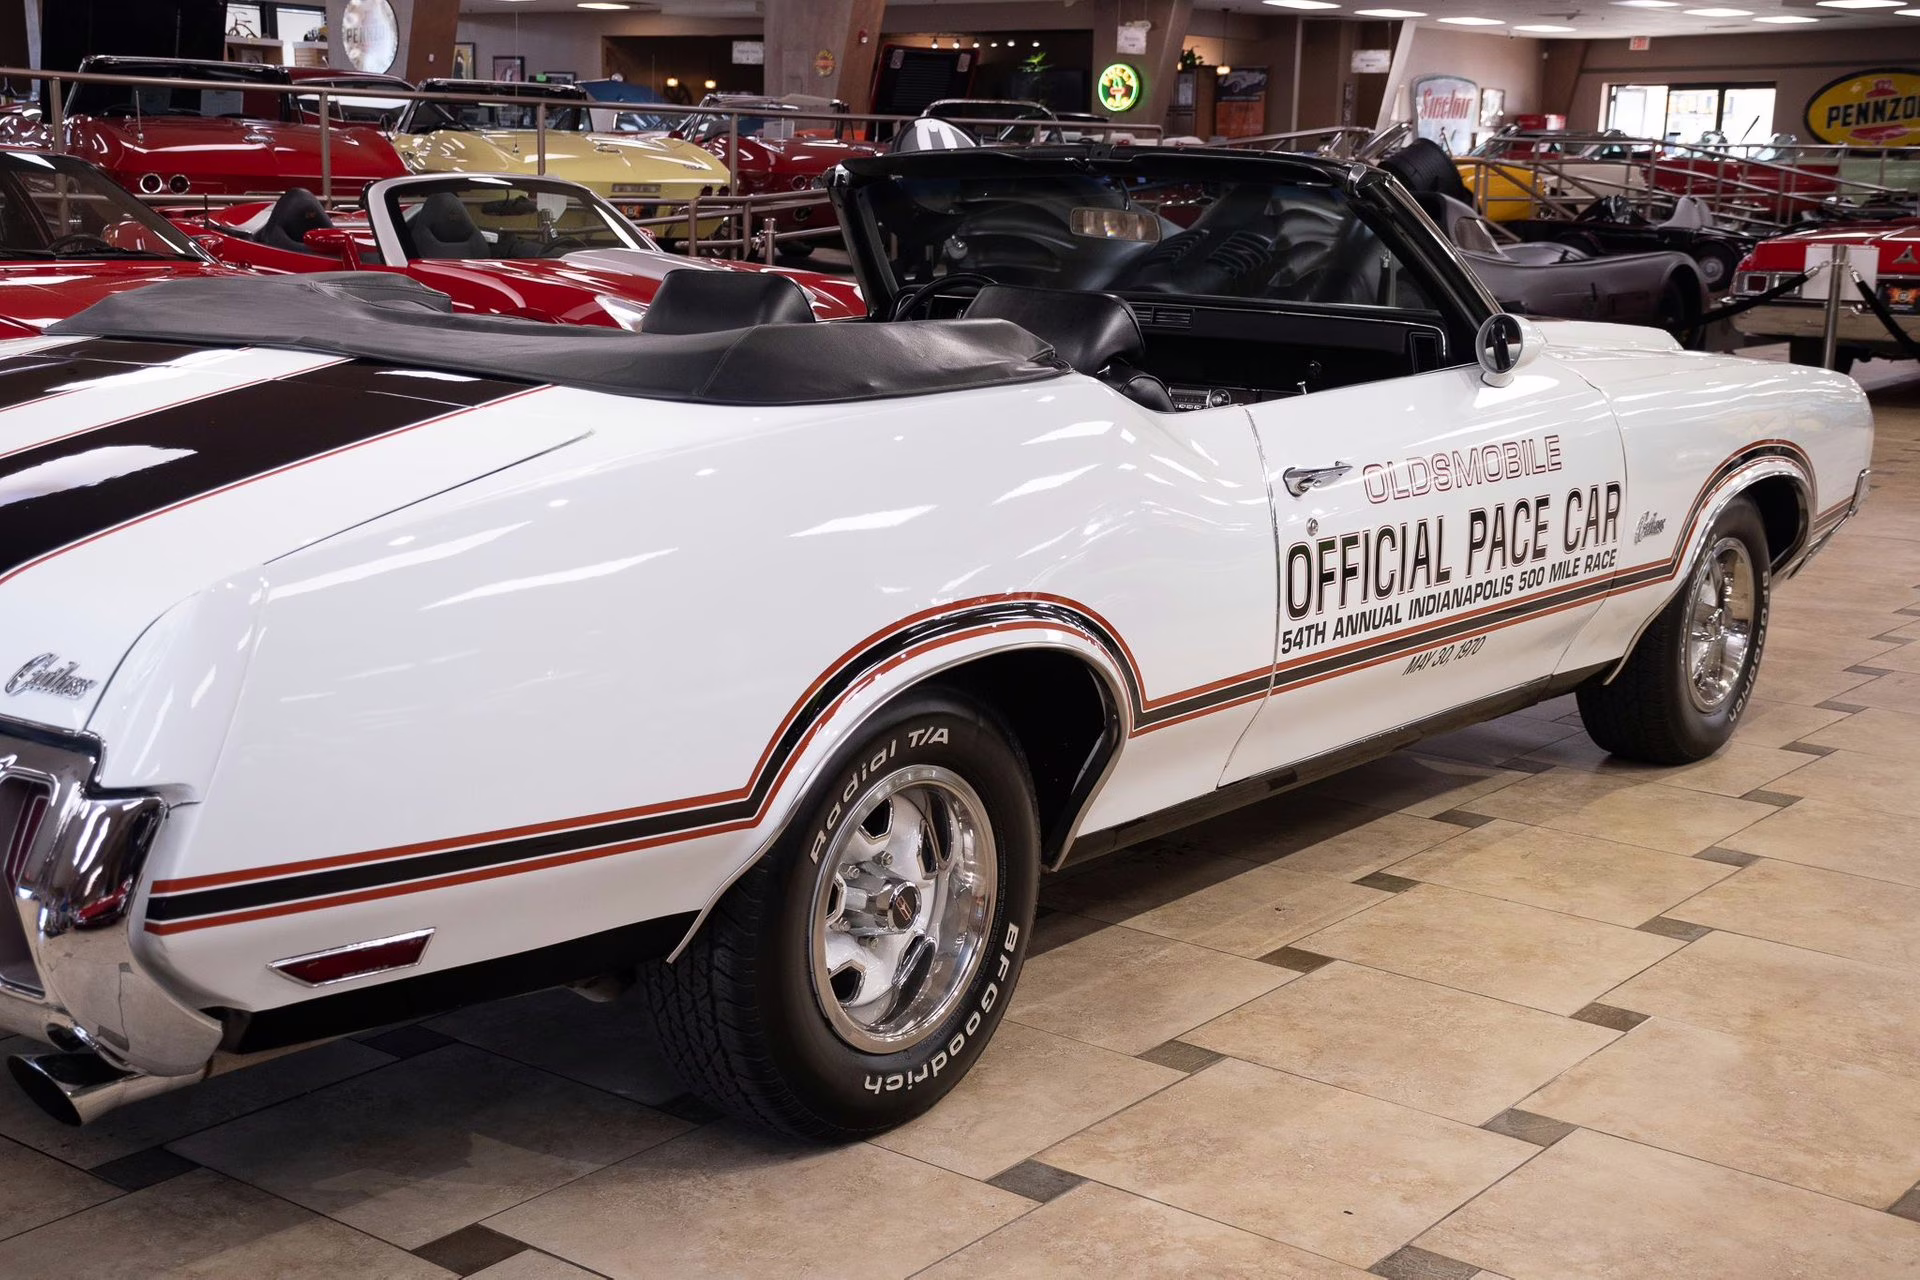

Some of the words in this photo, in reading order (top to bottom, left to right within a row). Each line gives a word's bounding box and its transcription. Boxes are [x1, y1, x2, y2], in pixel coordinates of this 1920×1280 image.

[1420, 87, 1473, 119] Sinclair
[1826, 95, 1920, 129] PENNZO
[1362, 434, 1562, 504] OLDSMOBILE
[1285, 515, 1453, 622] OFFICIAL
[1465, 494, 1551, 579] PACE
[1563, 480, 1621, 554] CAR
[1281, 621, 1327, 655] 54TH
[1332, 602, 1403, 641] ANNUAL
[1408, 573, 1514, 621] INDIANAPOLIS
[1518, 566, 1545, 592] 500
[1549, 557, 1581, 583] MILE
[1584, 549, 1618, 574] RACE
[1402, 649, 1439, 676] MAY
[1431, 644, 1456, 667] 30,
[1453, 635, 1487, 660] 1970
[809, 739, 897, 865] Radial
[907, 726, 950, 748] T/A
